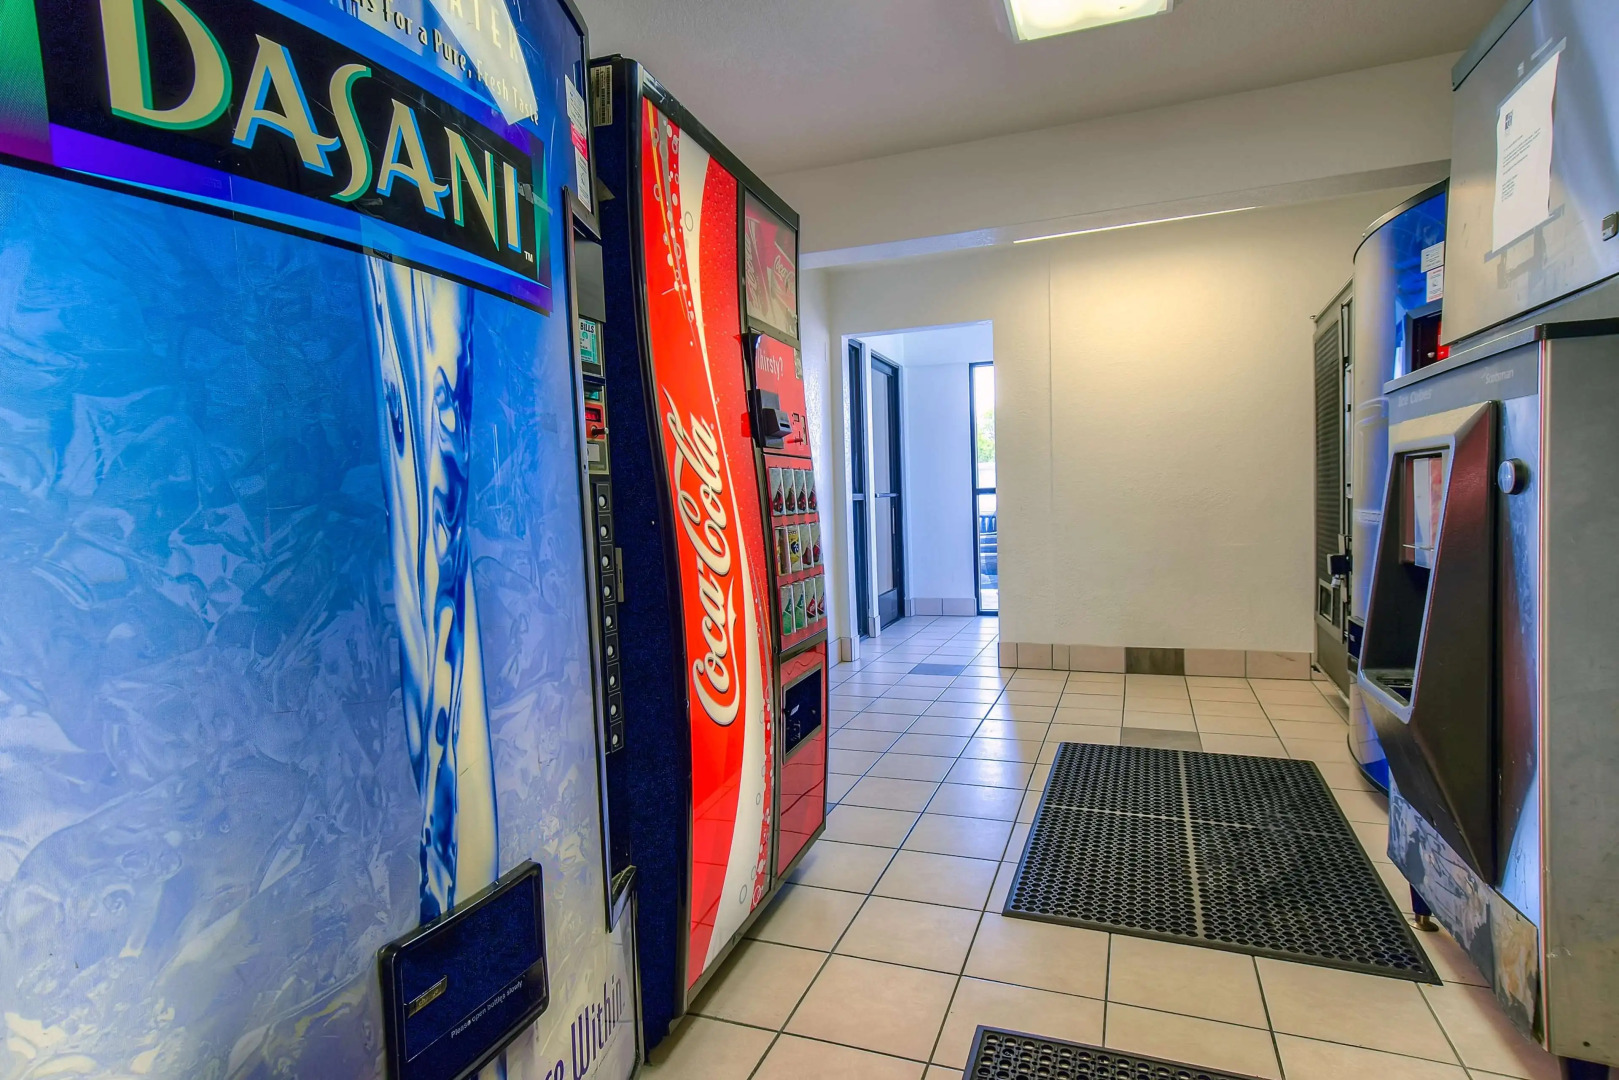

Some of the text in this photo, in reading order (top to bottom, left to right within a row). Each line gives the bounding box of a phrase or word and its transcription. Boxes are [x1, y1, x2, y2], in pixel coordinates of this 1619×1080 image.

[418, 26, 428, 46] a
[100, 0, 522, 253] DASANI
[580, 321, 595, 334] BILLS
[662, 384, 740, 726] Coca-Cola
[450, 979, 524, 1039] Please open bottles slowly
